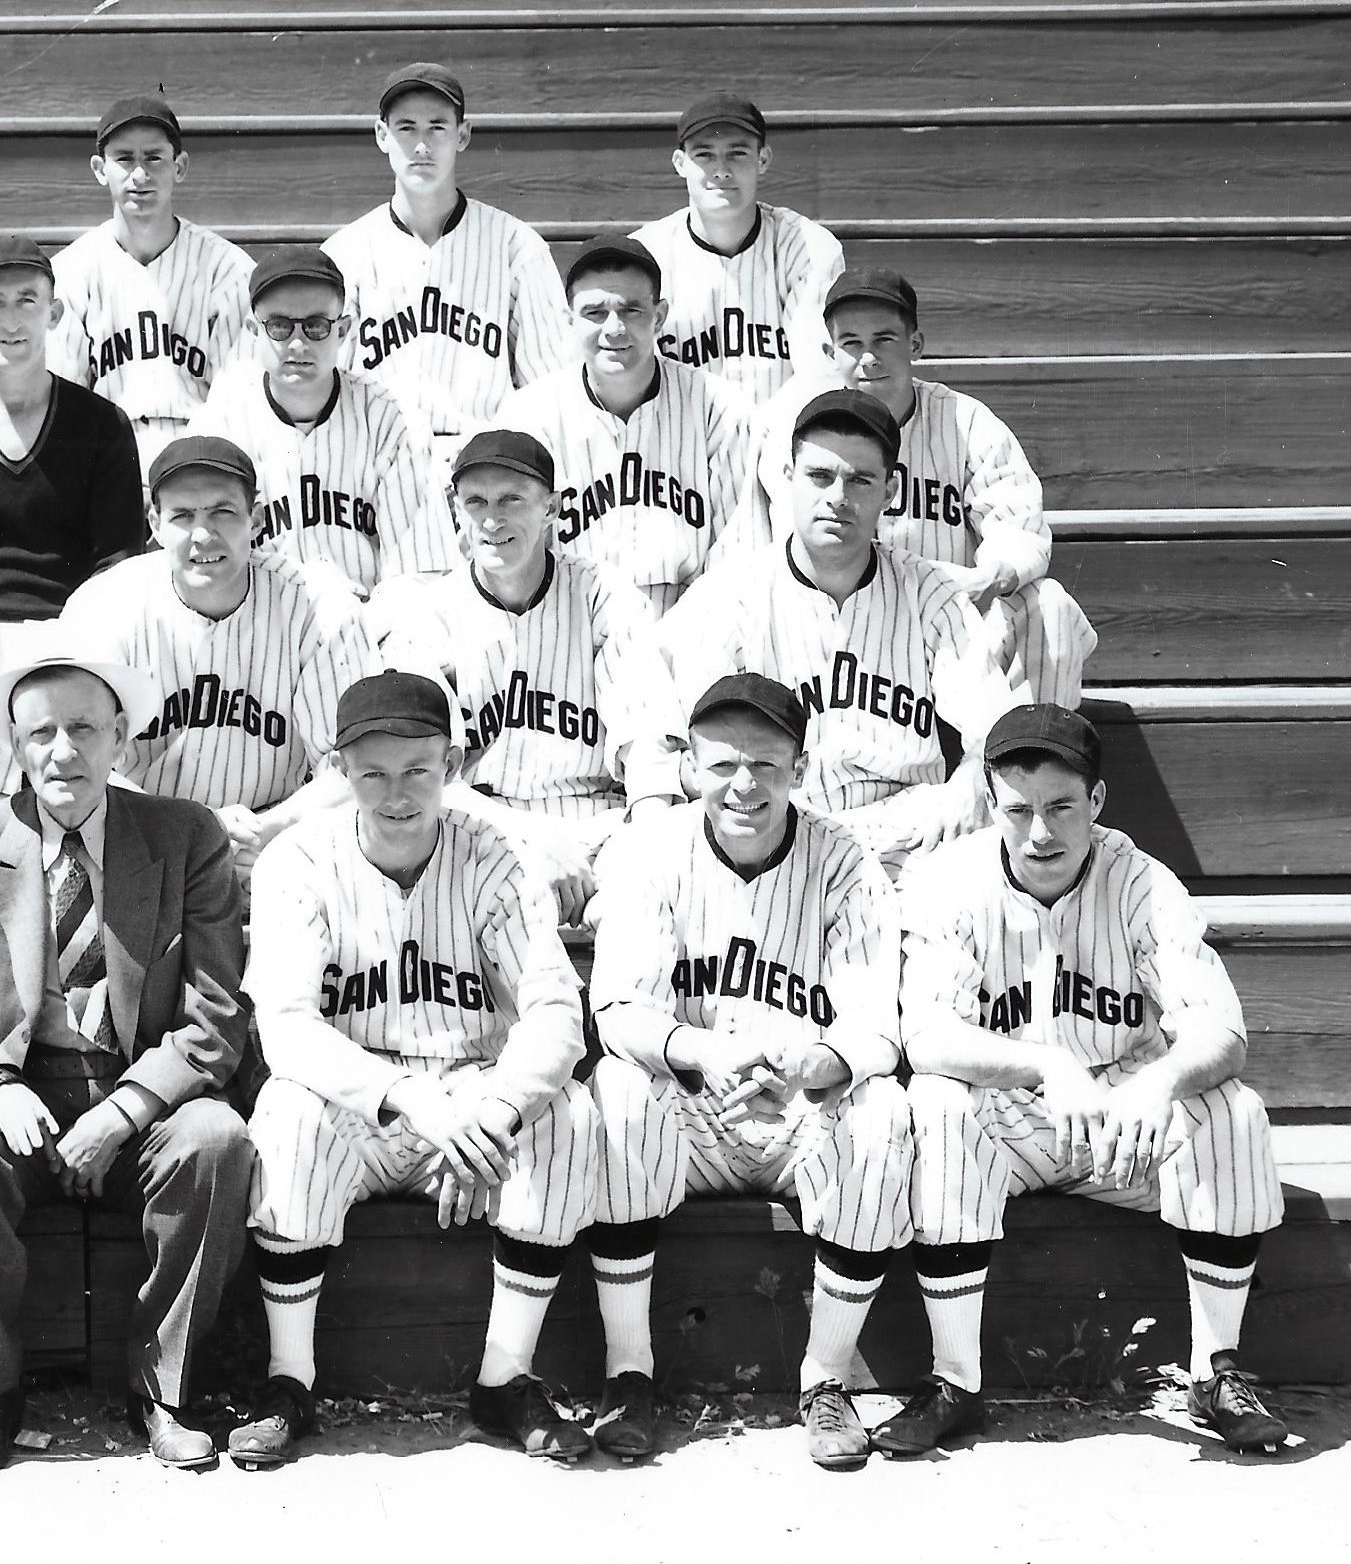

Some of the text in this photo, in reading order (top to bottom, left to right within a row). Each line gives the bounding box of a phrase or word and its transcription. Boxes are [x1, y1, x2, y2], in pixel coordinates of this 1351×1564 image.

[359, 286, 501, 369] SAN DIEGO
[251, 474, 376, 548] AN DIEGO
[557, 452, 704, 544] SAN DIEGO
[188, 674, 286, 747] DIEGO
[504, 671, 599, 747] DIEGO
[830, 651, 931, 738] DIEGO
[321, 960, 388, 1017] SAN
[671, 937, 837, 1027] AN DIEGO
